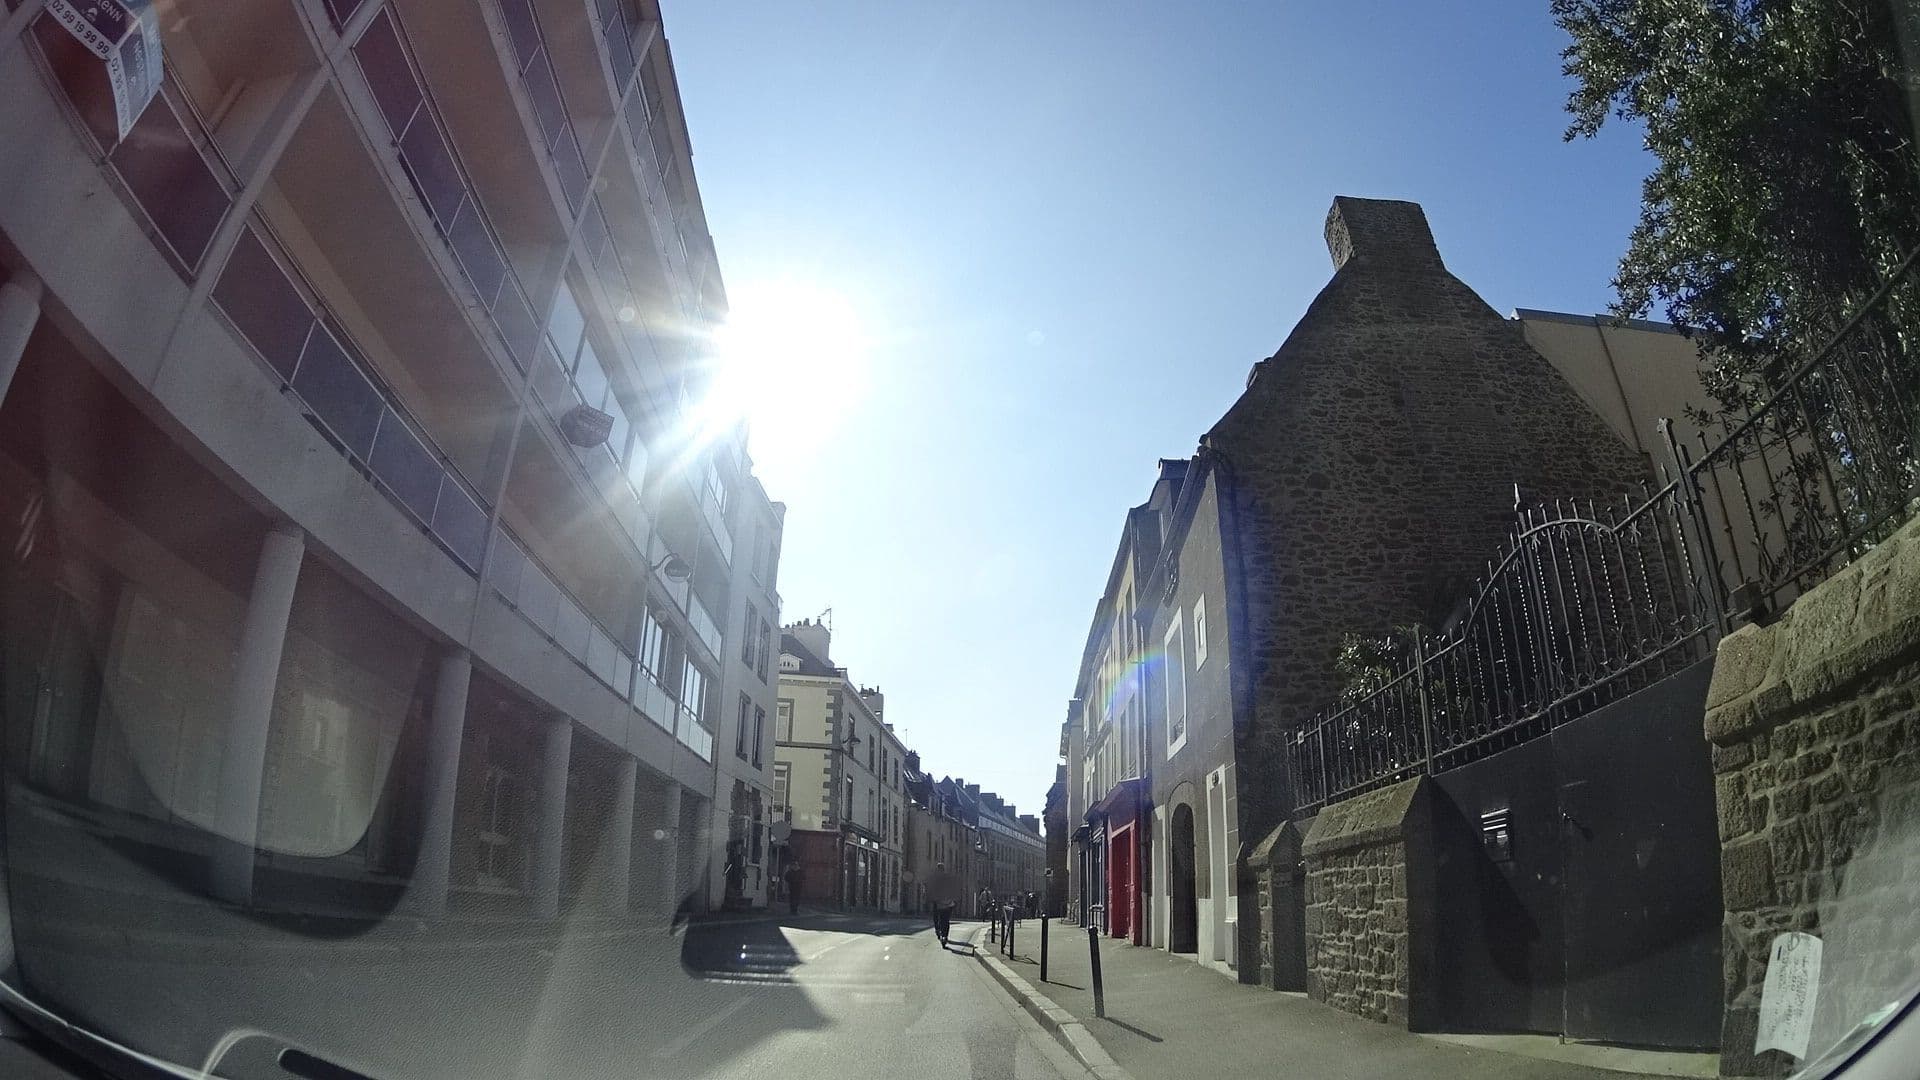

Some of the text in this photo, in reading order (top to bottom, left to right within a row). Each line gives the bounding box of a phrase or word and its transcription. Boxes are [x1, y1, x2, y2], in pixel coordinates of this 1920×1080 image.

[52, 1, 110, 54] 02 99 19 99 99
